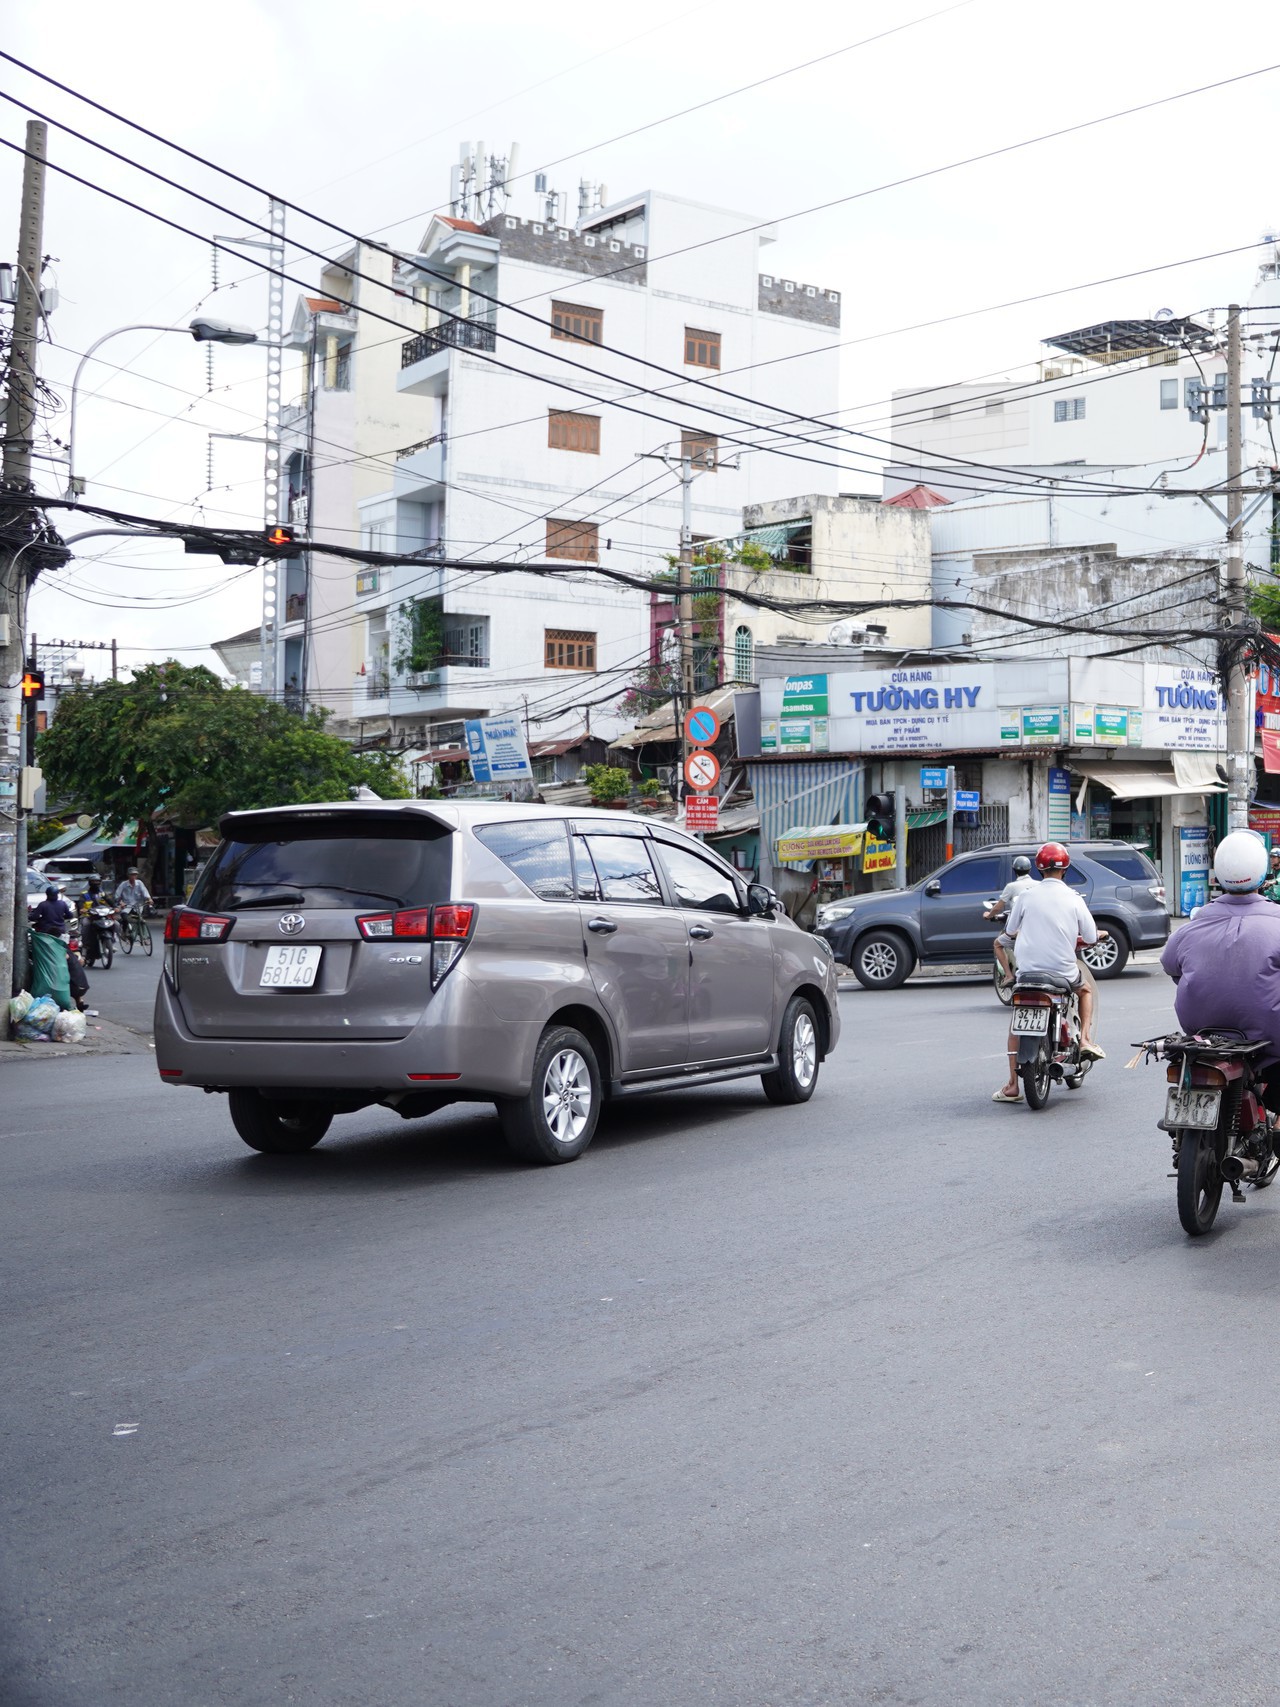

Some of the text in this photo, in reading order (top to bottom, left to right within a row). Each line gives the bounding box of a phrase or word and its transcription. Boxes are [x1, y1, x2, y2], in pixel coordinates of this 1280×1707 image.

[891, 671, 932, 683] CỬA HÀNG
[1181, 669, 1217, 682] CỬA HÀN
[850, 685, 982, 713] TƯỜNG HY
[1156, 681, 1217, 710] TƯỜNG
[278, 947, 308, 965] 51G
[262, 966, 313, 985] 581.40
